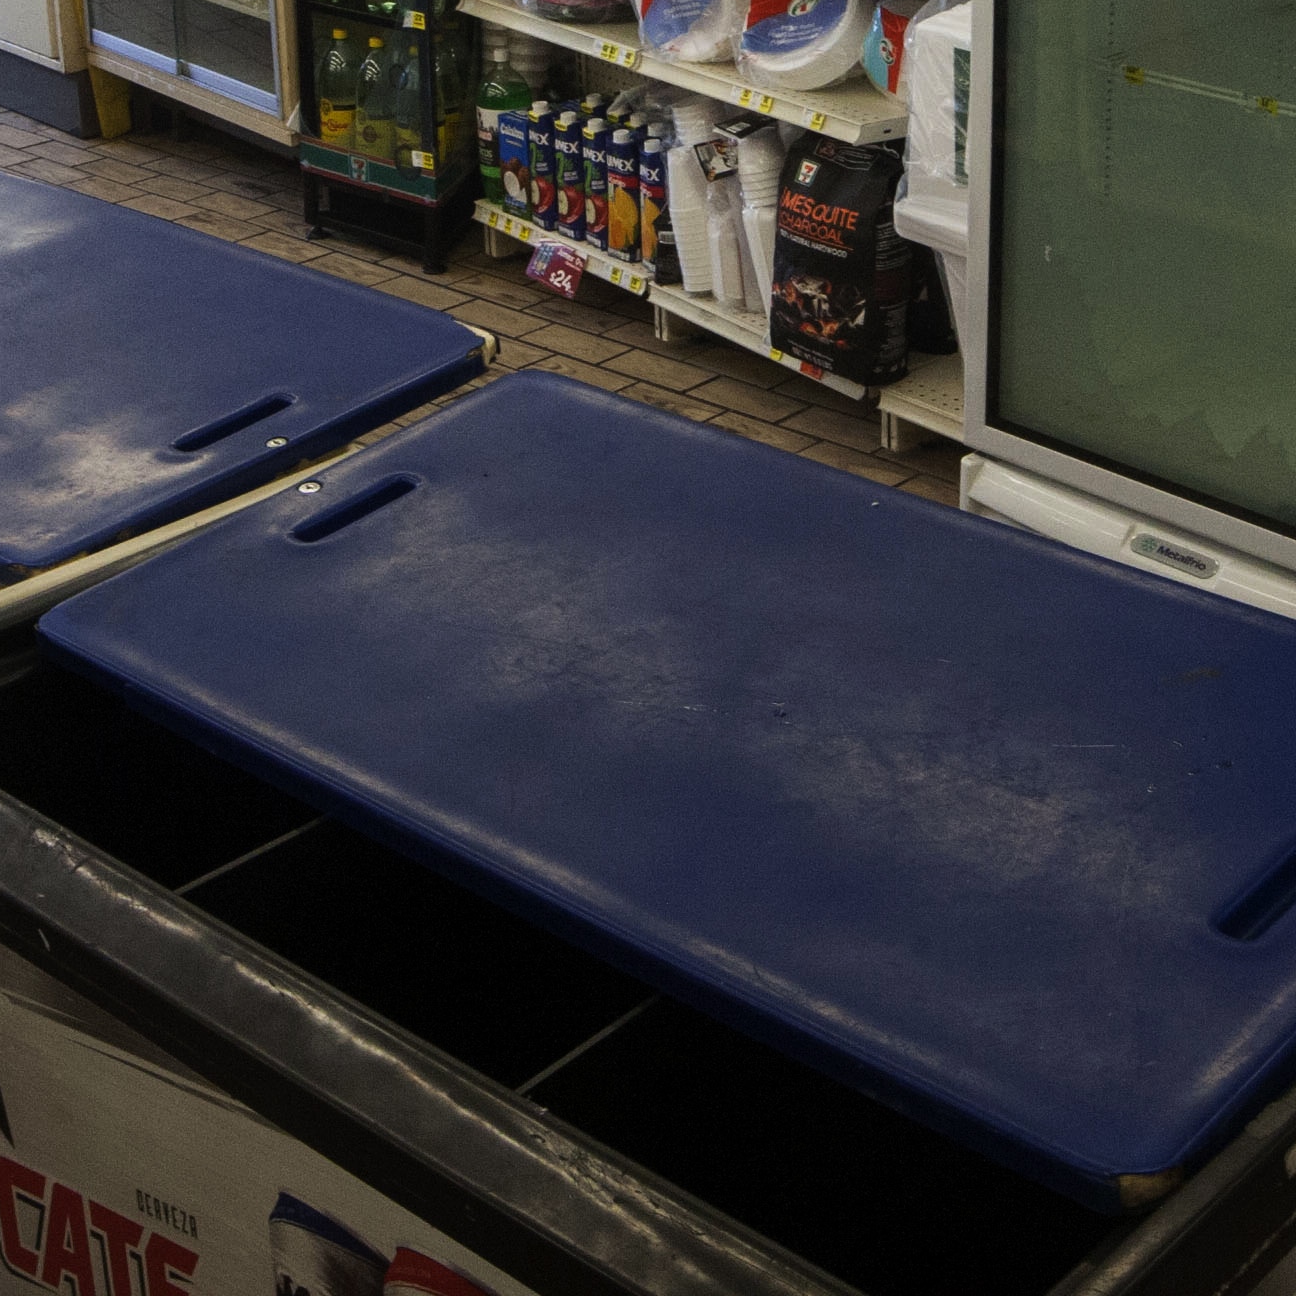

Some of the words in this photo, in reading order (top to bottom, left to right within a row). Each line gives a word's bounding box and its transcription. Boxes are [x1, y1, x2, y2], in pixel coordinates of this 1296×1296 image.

[779, 211, 845, 246] CHARCOAL
[782, 186, 860, 231] MESQUITE
[1156, 544, 1207, 572] Metalfrio
[135, 1189, 200, 1241] CERVEZA
